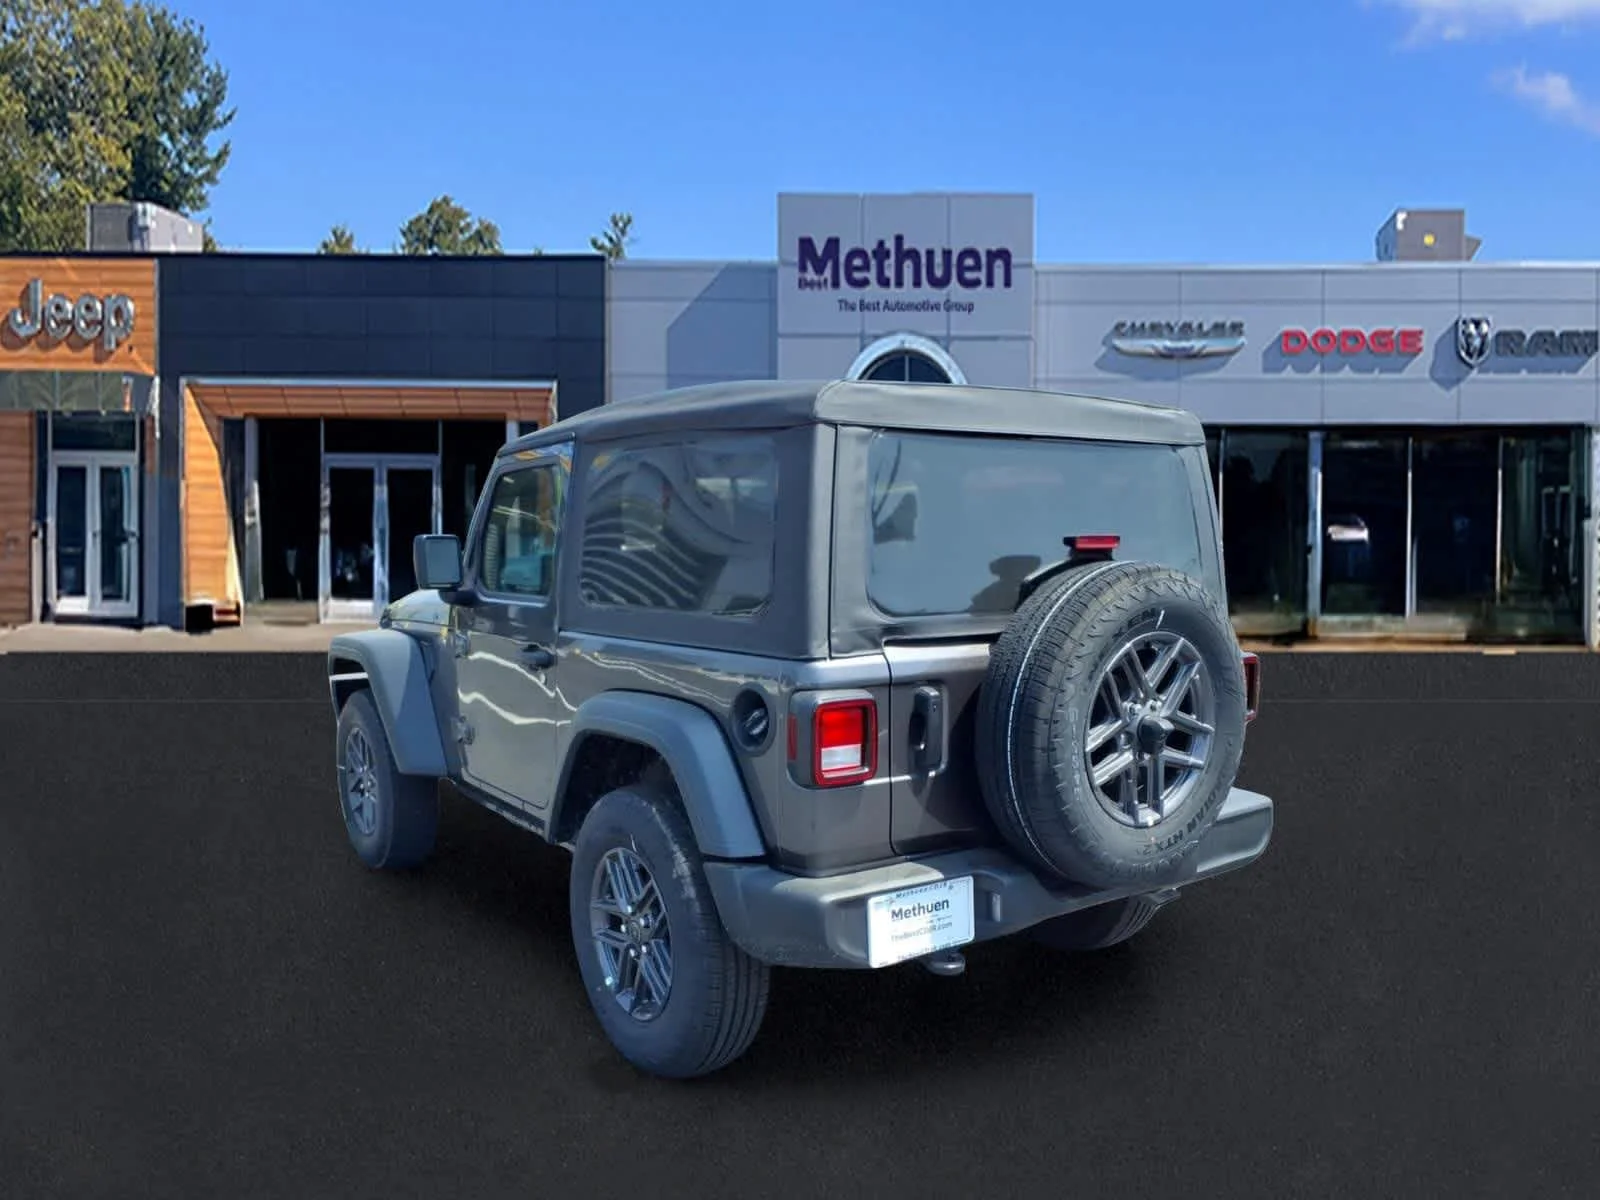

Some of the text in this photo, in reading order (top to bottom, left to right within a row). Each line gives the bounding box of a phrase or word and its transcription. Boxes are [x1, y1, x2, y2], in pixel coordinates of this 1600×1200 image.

[798, 234, 1012, 289] Methuen
[9, 278, 135, 351] Jeep
[838, 300, 975, 314] The Best Automotive Group
[1281, 328, 1424, 355] DODGE
[1495, 329, 1599, 357] RAM
[891, 899, 949, 920] Methuen
